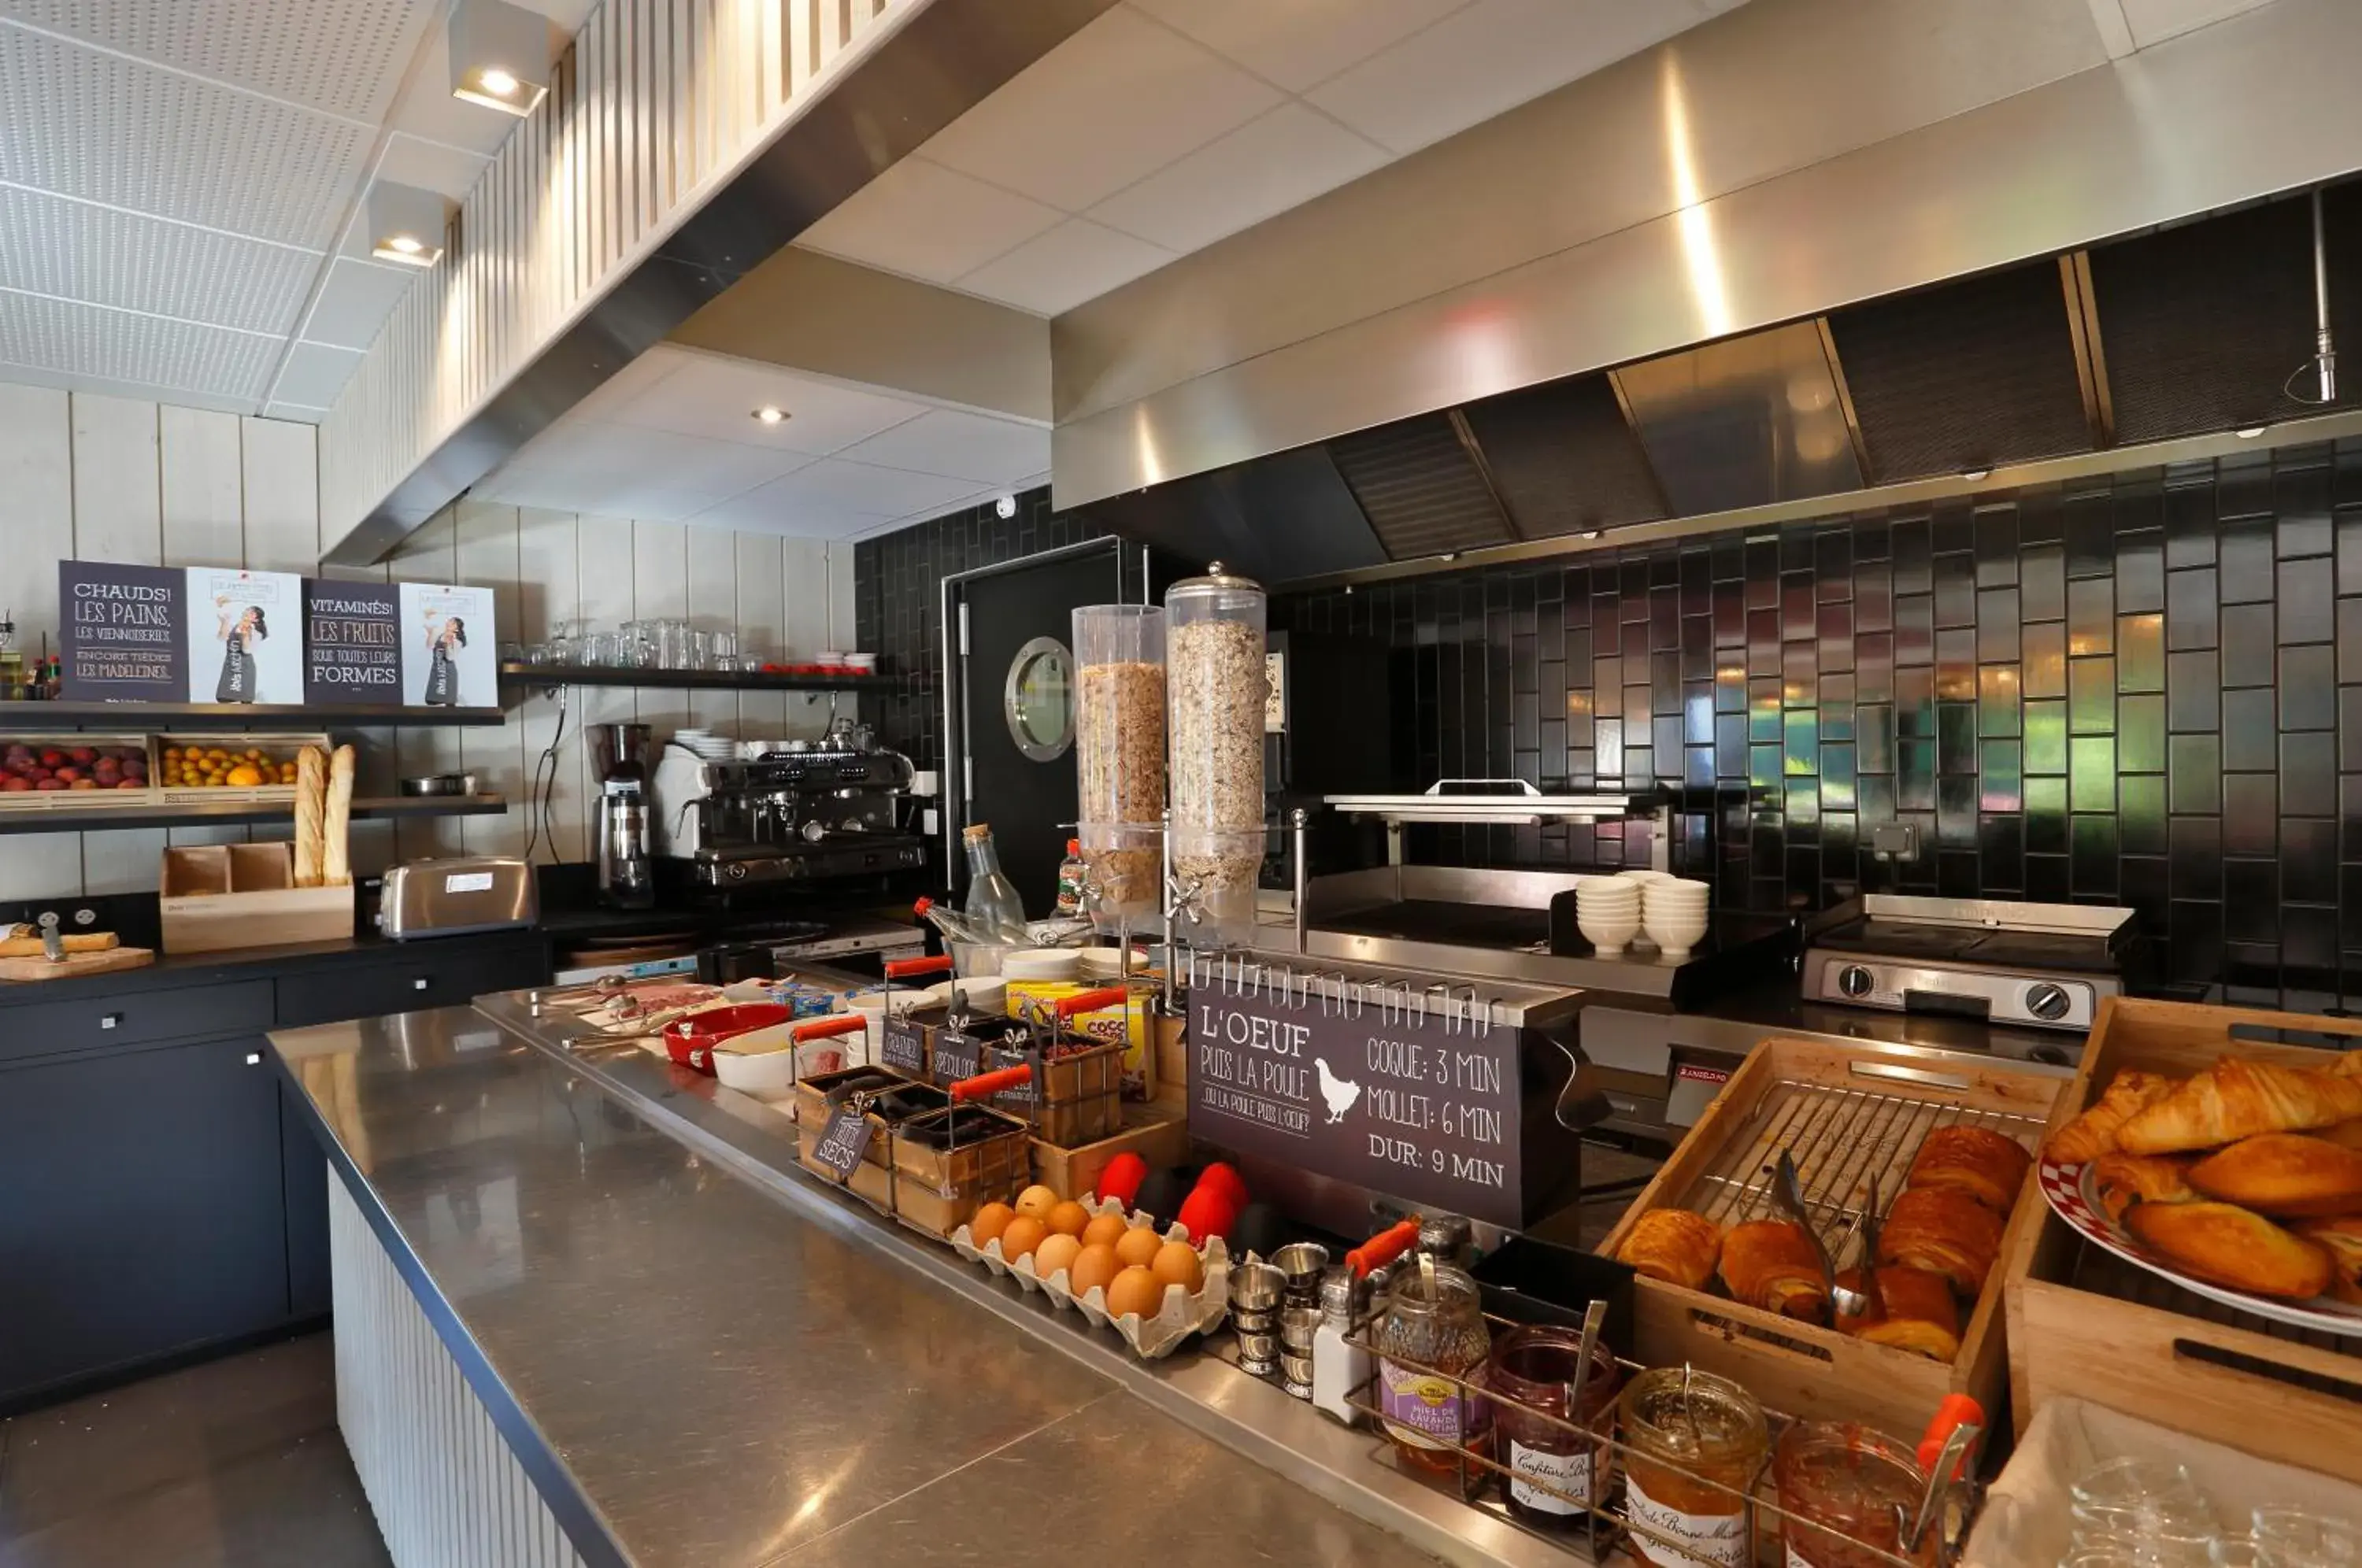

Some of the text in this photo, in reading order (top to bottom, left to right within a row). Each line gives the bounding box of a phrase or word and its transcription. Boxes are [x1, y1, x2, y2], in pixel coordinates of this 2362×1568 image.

[74, 583, 171, 602] CHAUDS!
[75, 601, 105, 623] LES
[310, 599, 393, 615] VITAMINÉS!
[75, 626, 93, 639] LES
[312, 619, 394, 644] LES FRUITS
[76, 651, 128, 661] ENCORE
[337, 649, 368, 664] TOUTES
[76, 664, 95, 677] LES
[313, 666, 396, 684] FORMES
[1201, 1005, 1310, 1057] L'OEUF
[1201, 1045, 1310, 1101] PUIS LA POULE
[1368, 1037, 1500, 1095] COQUE: 3 MIN
[1218, 1089, 1229, 1110] LA
[1231, 1093, 1256, 1117] POULE
[1257, 1101, 1276, 1124] PUIS
[1368, 1086, 1501, 1145] MOLLET: 6 MIN
[819, 1139, 855, 1169] SECS
[1368, 1133, 1505, 1189] DUR: 9 MIN
[1412, 1404, 1438, 1416] MIEL
